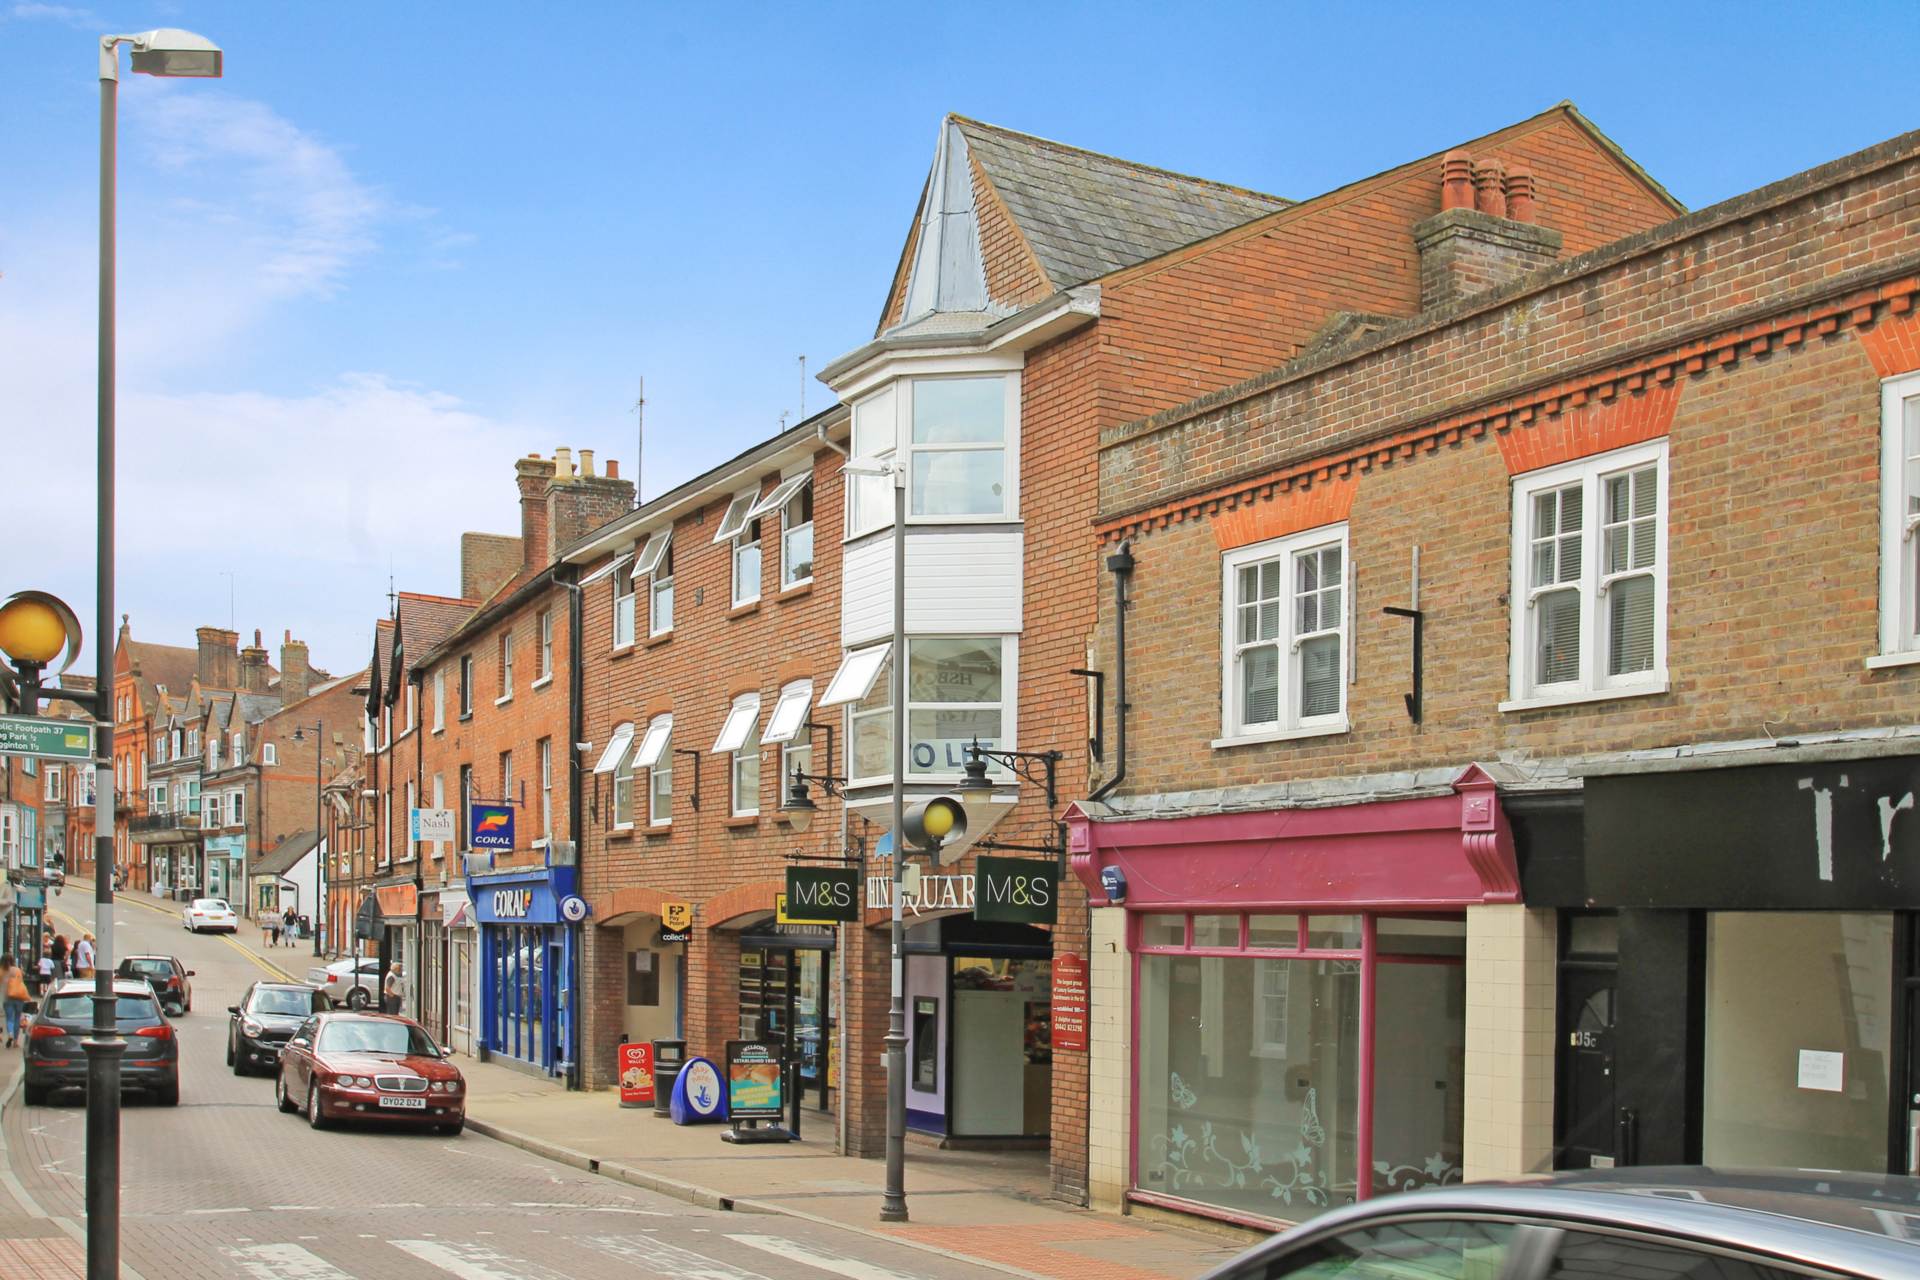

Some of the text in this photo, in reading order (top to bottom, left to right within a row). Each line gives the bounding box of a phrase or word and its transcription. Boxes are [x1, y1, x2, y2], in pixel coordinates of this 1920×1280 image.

[9, 732, 28, 741] Park
[15, 724, 52, 734] Footpath
[946, 742, 994, 768] LET
[423, 818, 450, 829] Nash
[475, 836, 511, 845] CORAL
[795, 881, 851, 907] M&S
[986, 874, 1049, 907] M&S
[493, 889, 527, 917] CORAL
